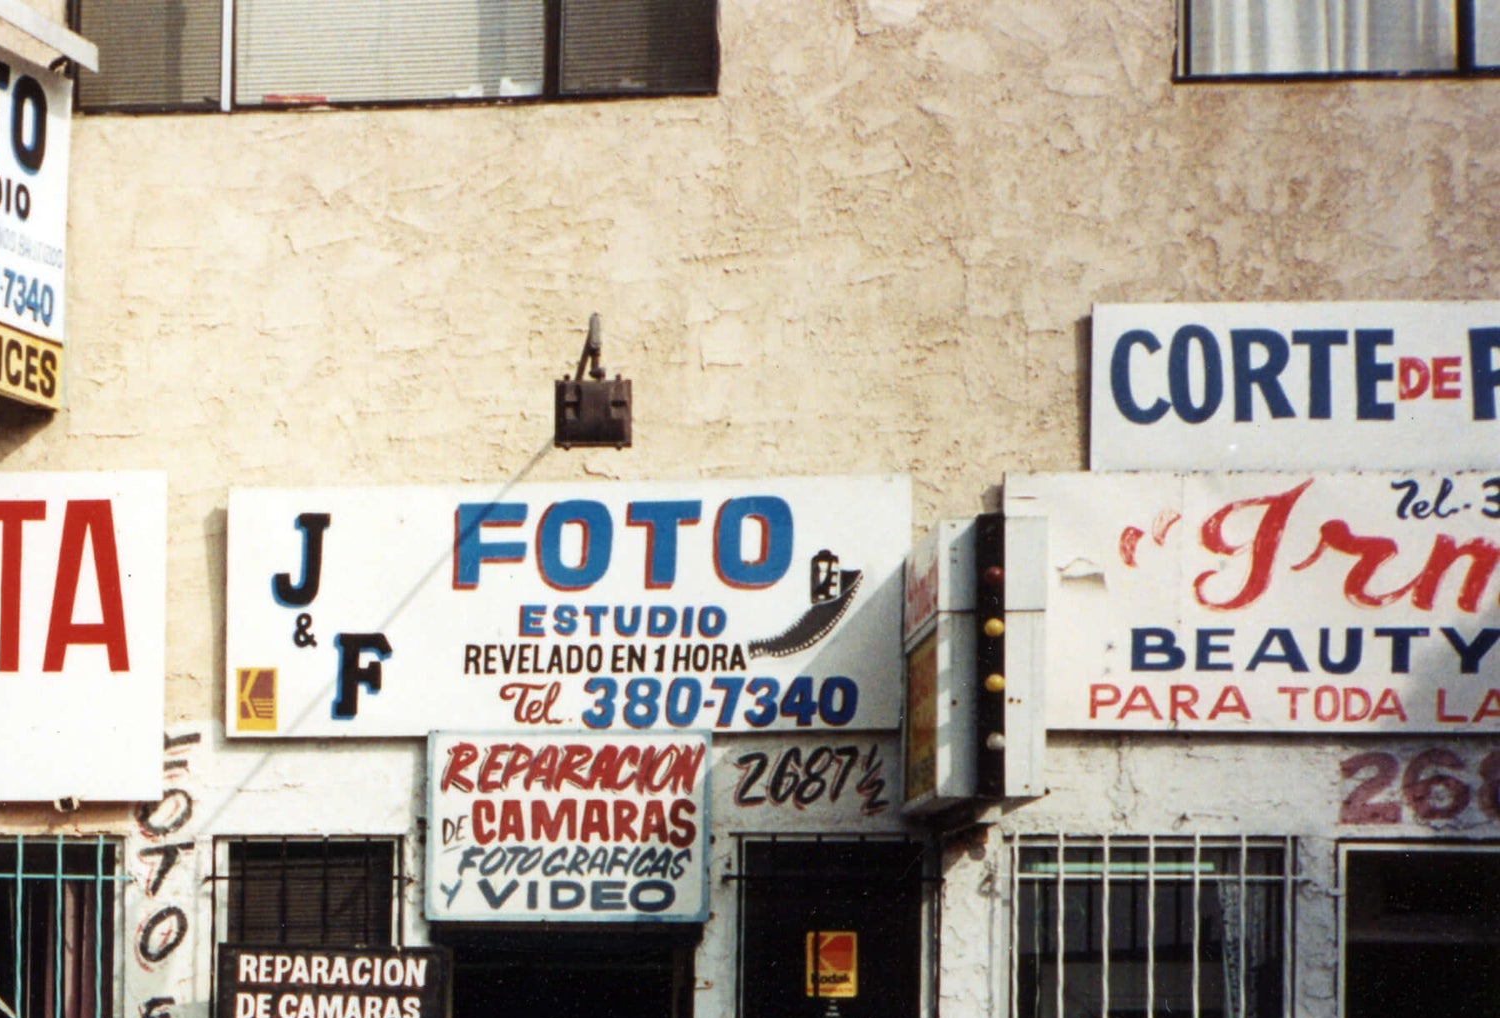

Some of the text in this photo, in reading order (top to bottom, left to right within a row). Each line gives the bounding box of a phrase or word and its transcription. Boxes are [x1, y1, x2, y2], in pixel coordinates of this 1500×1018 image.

[1110, 324, 1395, 424] CORTE
[1398, 356, 1461, 400] DE
[451, 494, 795, 592] FOTO
[272, 512, 392, 721] J & F
[518, 604, 728, 639] ESTUDIO
[463, 643, 747, 675] REVELADO EN 1 HORA
[1130, 627, 1500, 675] BEAUTY
[581, 675, 859, 729] 380-7340
[1089, 683, 1500, 724] PARA TODA LA
[441, 741, 706, 797] REPARACION
[442, 798, 697, 848] DE CAMARAS
[458, 845, 692, 880] FOTOGRAFICAS
[477, 877, 676, 913] VIDEO
[239, 953, 427, 988] REPARACION
